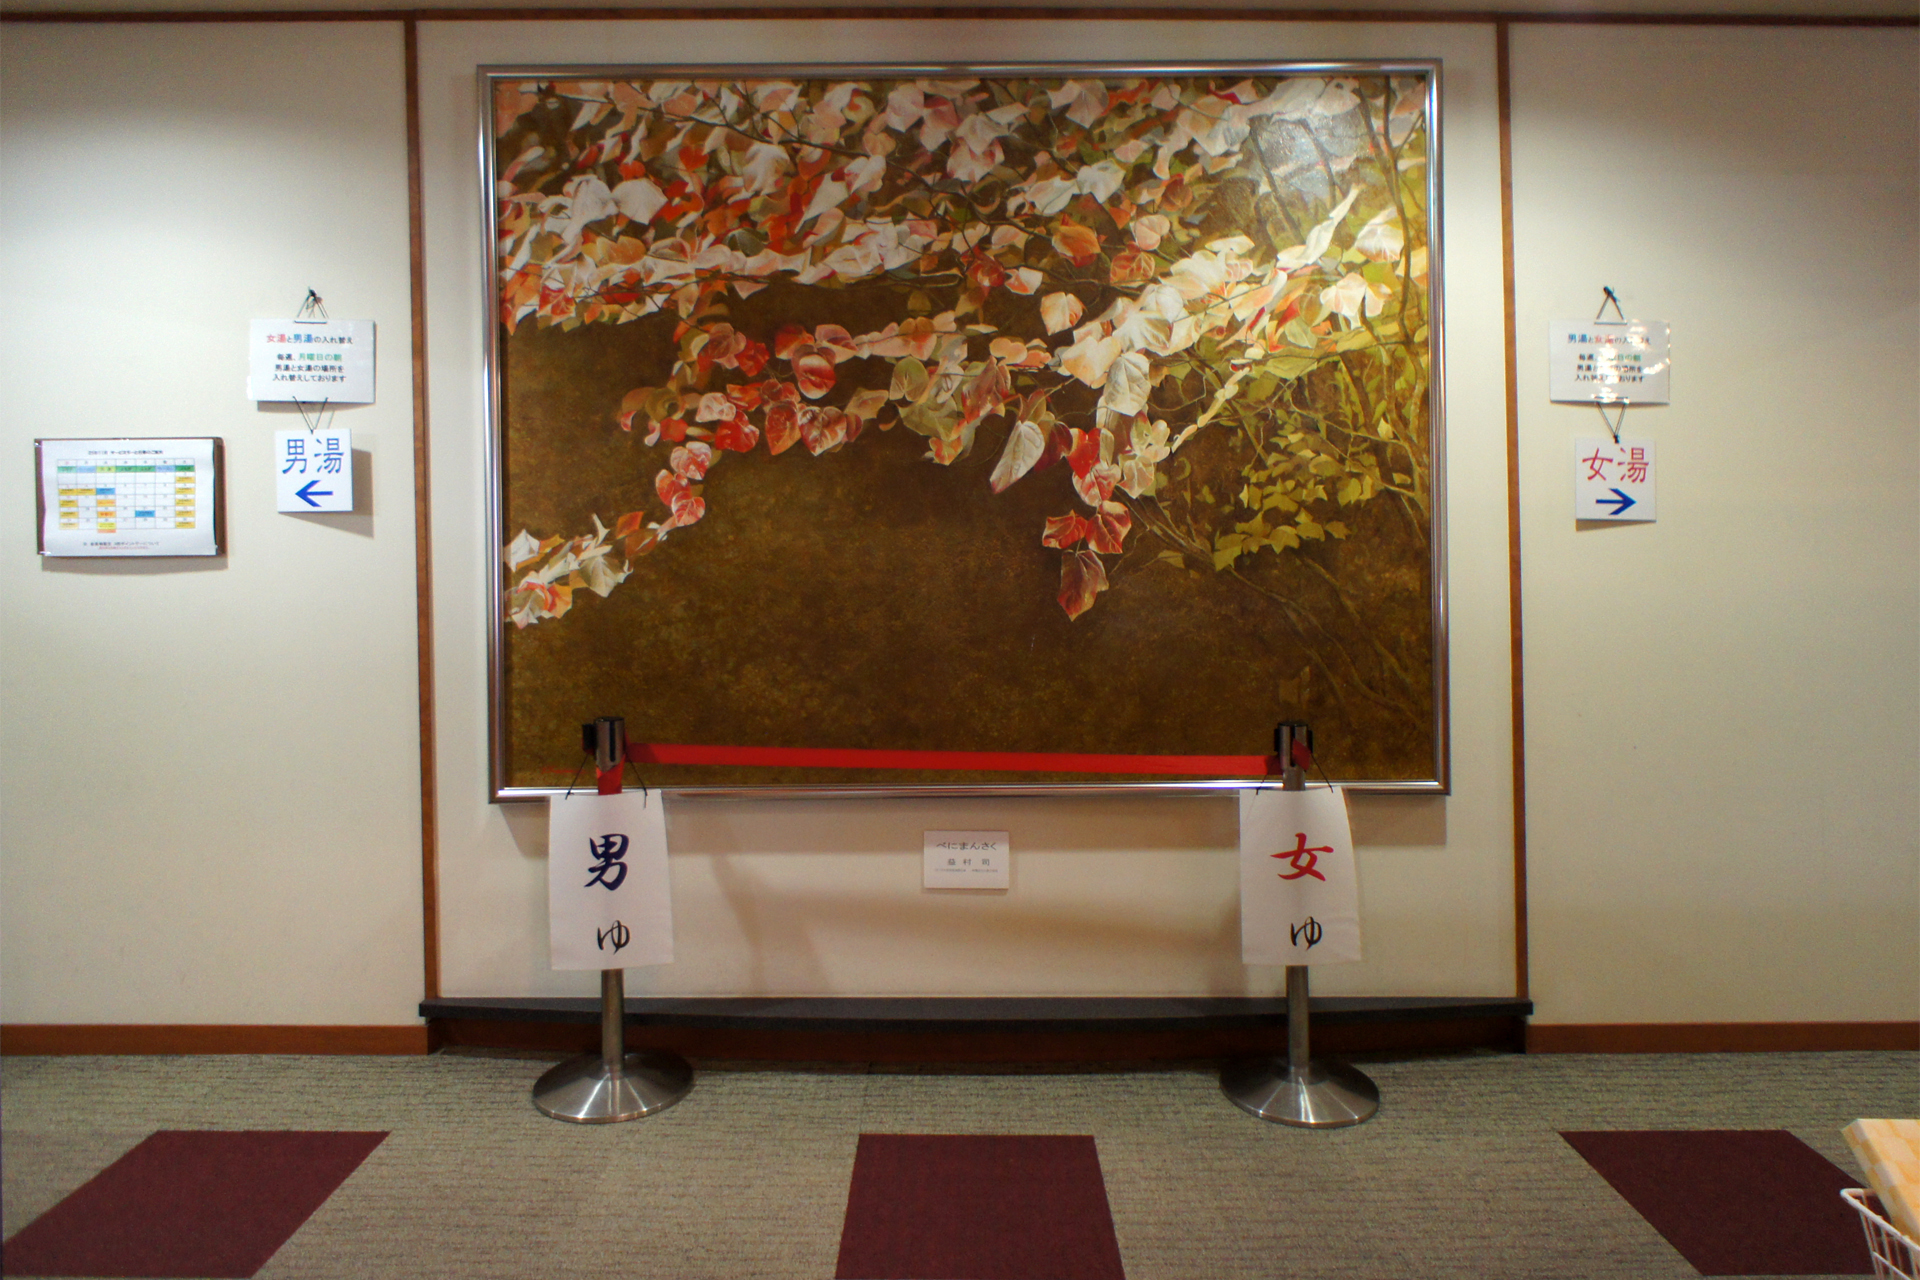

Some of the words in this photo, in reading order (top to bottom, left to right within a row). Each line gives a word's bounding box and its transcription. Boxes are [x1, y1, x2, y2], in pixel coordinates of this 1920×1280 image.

[266, 333, 353, 344] 女湯と男湯の入れ替え
[273, 373, 346, 382] 入れ替えしております
[275, 364, 344, 373] 男湯と女湯の場所を
[282, 437, 344, 474] 男湯
[1582, 447, 1649, 483] 女湯
[584, 833, 630, 891] 男
[936, 842, 997, 851] べにまんさく
[1270, 832, 1334, 882] 女
[597, 920, 630, 954] ゆ
[1290, 916, 1322, 951] ゆ
